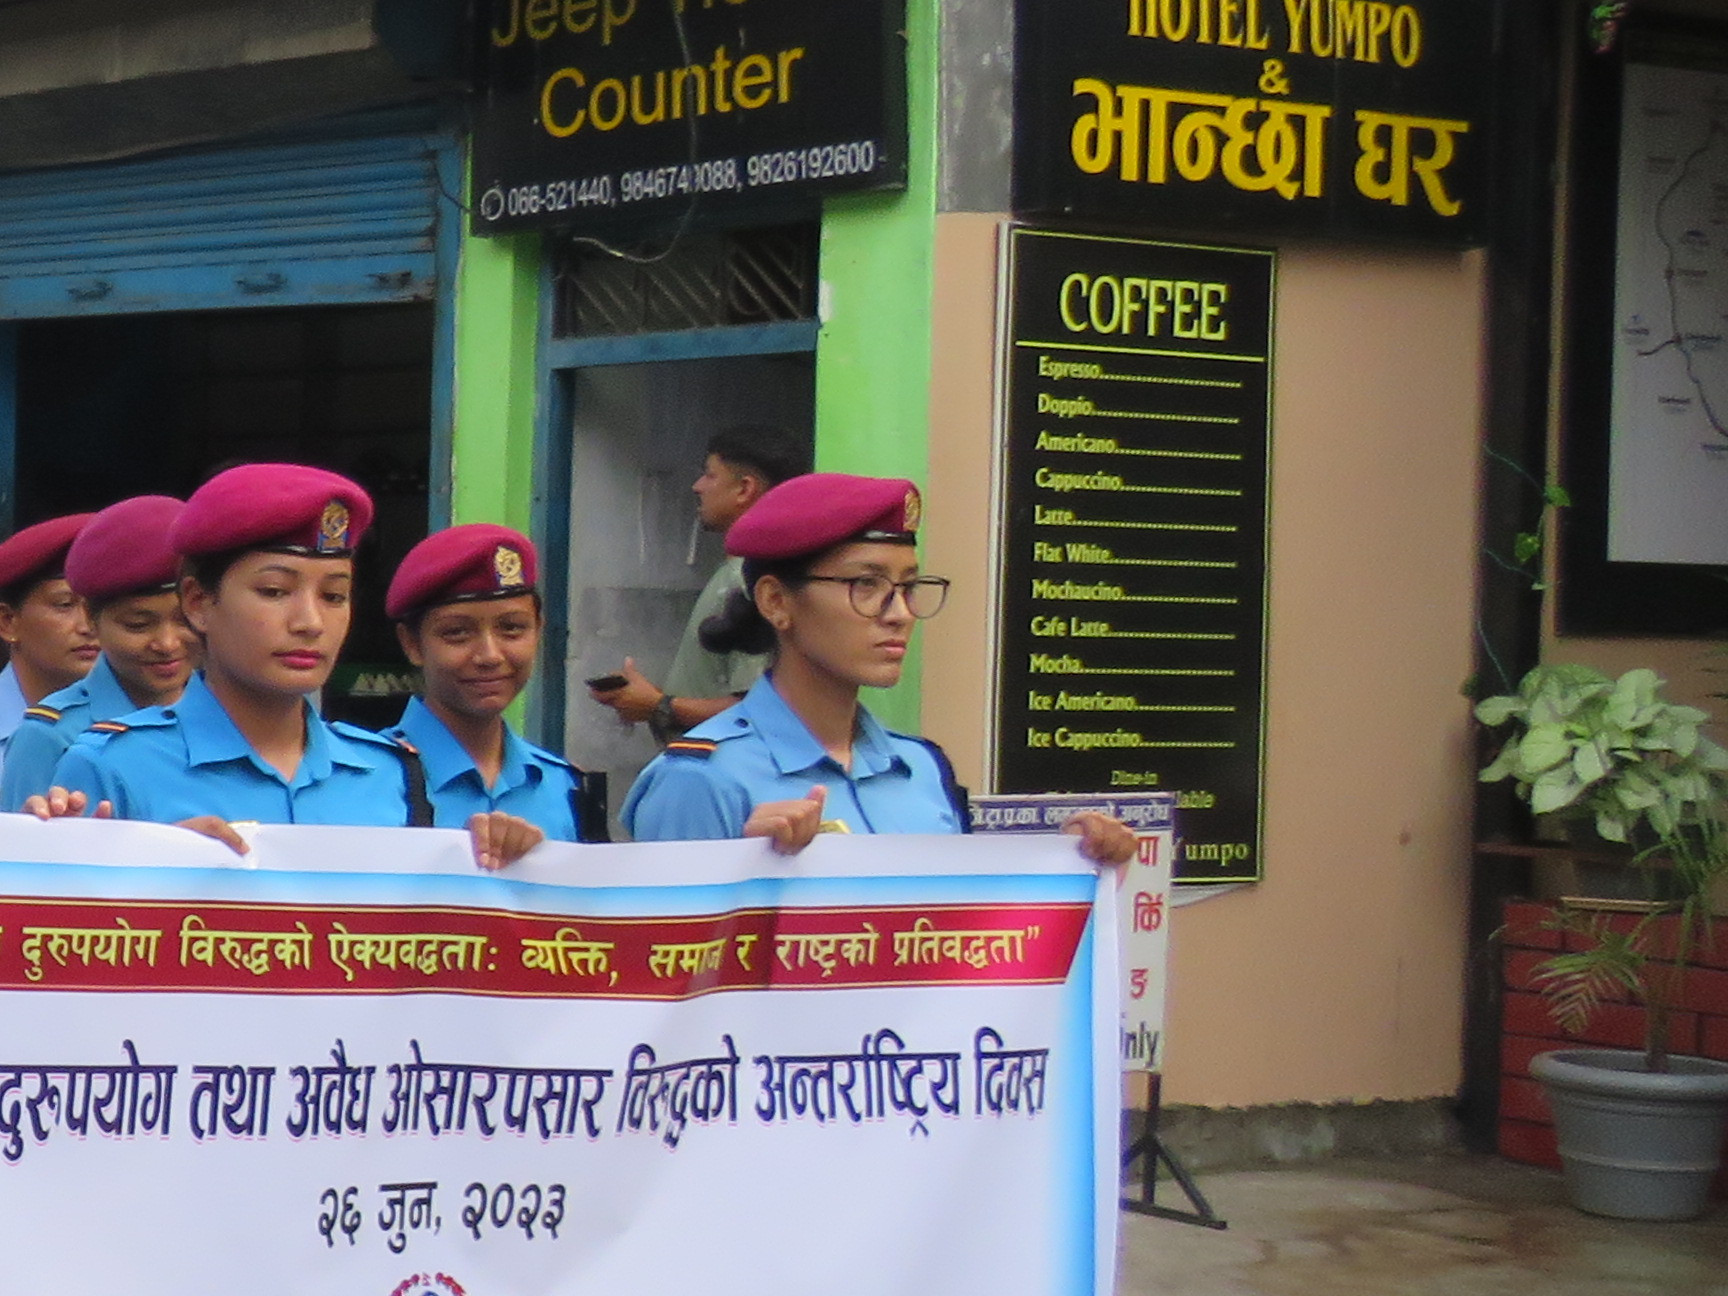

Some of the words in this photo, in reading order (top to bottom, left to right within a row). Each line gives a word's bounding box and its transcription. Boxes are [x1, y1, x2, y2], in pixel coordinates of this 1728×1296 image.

[1258, 58, 1290, 96] &
[540, 45, 806, 138] Counter
[1071, 76, 1332, 201] भान्छा
[1354, 109, 1470, 217] घर
[508, 174, 616, 216] 066-521440,
[747, 140, 875, 187] 9826192600
[1060, 272, 1228, 341] COFFEE
[1038, 356, 1101, 380] Espresso
[1038, 393, 1093, 418] Doppio
[1035, 431, 1116, 452] Americano
[1035, 468, 1122, 492] Cappuccino
[1034, 505, 1074, 524] Latte
[1033, 542, 1062, 562] Flat
[1066, 543, 1112, 564] White
[1032, 579, 1124, 600] Mochaucino
[1031, 616, 1067, 636] Cafe
[1071, 617, 1110, 637] Latte
[1029, 654, 1082, 673] Mocha
[1028, 691, 1052, 710] Ice
[1055, 691, 1136, 711] Americano
[1027, 728, 1050, 747] Ice
[1054, 727, 1142, 750] Cappuccino
[22, 917, 162, 981] दुरुपयोग
[179, 913, 313, 975] विरुद्धको
[520, 927, 619, 986] व्यक्ति,
[649, 936, 727, 978] समाज
[736, 932, 759, 972] र
[775, 922, 879, 977] राष्ट्रको
[1121, 1021, 1161, 1067] nly
[189, 1064, 276, 1141] तथा
[286, 1039, 375, 1139] अवैध
[381, 1039, 614, 1140] ओसारपसार
[973, 1026, 1049, 1119] दिवस
[318, 1187, 362, 1248] २६
[378, 1181, 442, 1254] जुन,
[461, 1182, 566, 1241] २०२३
